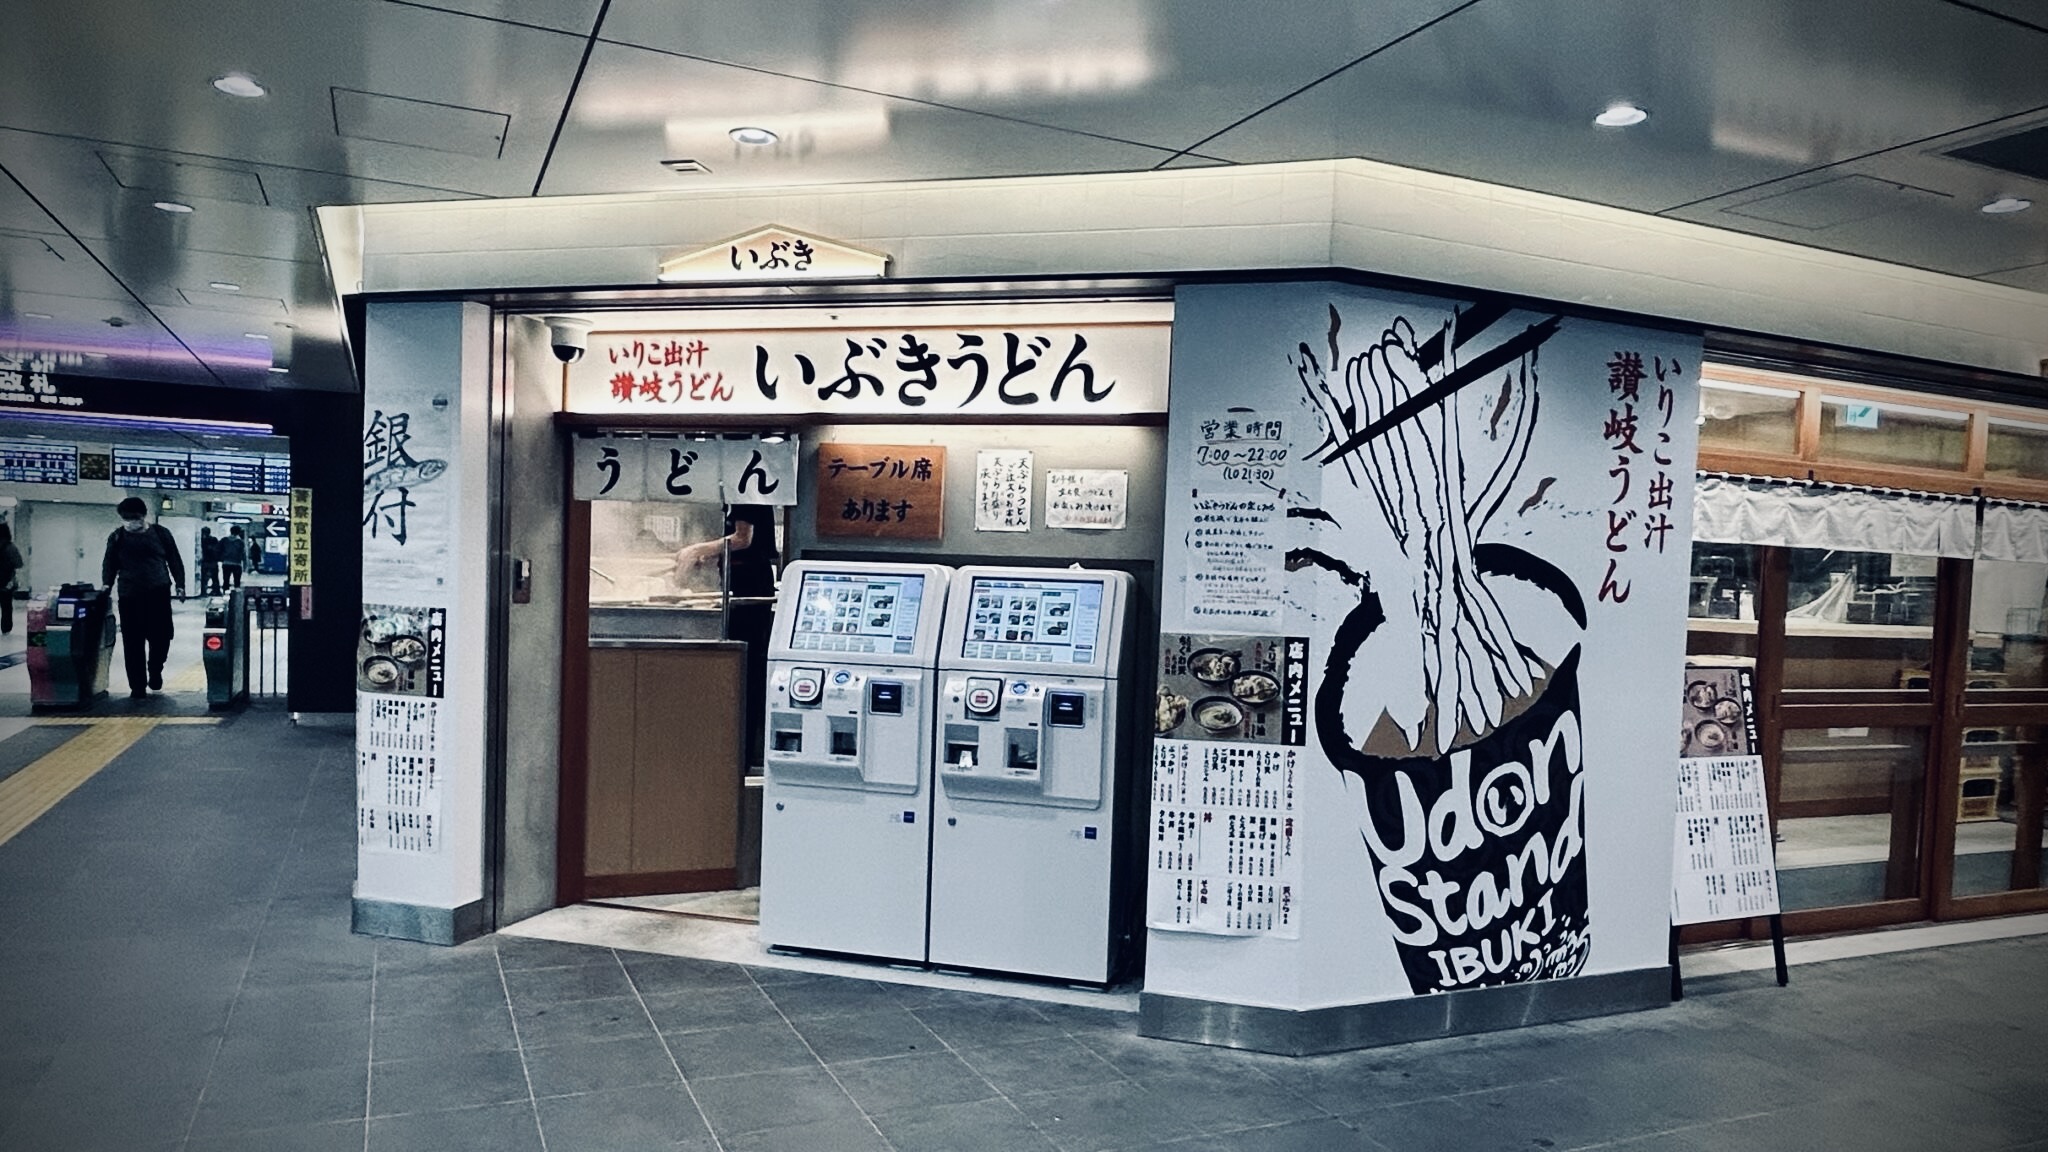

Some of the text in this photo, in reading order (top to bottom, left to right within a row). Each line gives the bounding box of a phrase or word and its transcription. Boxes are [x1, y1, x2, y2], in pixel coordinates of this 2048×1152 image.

[731, 239, 815, 272] いぶき
[609, 340, 709, 368] いりこ出汁
[609, 370, 734, 404] 讃岐うどん
[755, 331, 1116, 409] いぶきうどん
[1201, 420, 1283, 440] 営業時間
[1644, 355, 1682, 555] いりこ出汁
[596, 448, 780, 496] うどん
[829, 456, 933, 481] テーブル席
[1017, 457, 1029, 526] 天ぷらうどん
[1598, 350, 1648, 604] 讃岐うどん
[841, 500, 914, 522] あります
[1287, 641, 1305, 744] 店内メニュー
[1343, 709, 1582, 869] Udon
[1379, 771, 1585, 947] Stand
[1428, 887, 1557, 987] IBUKI
